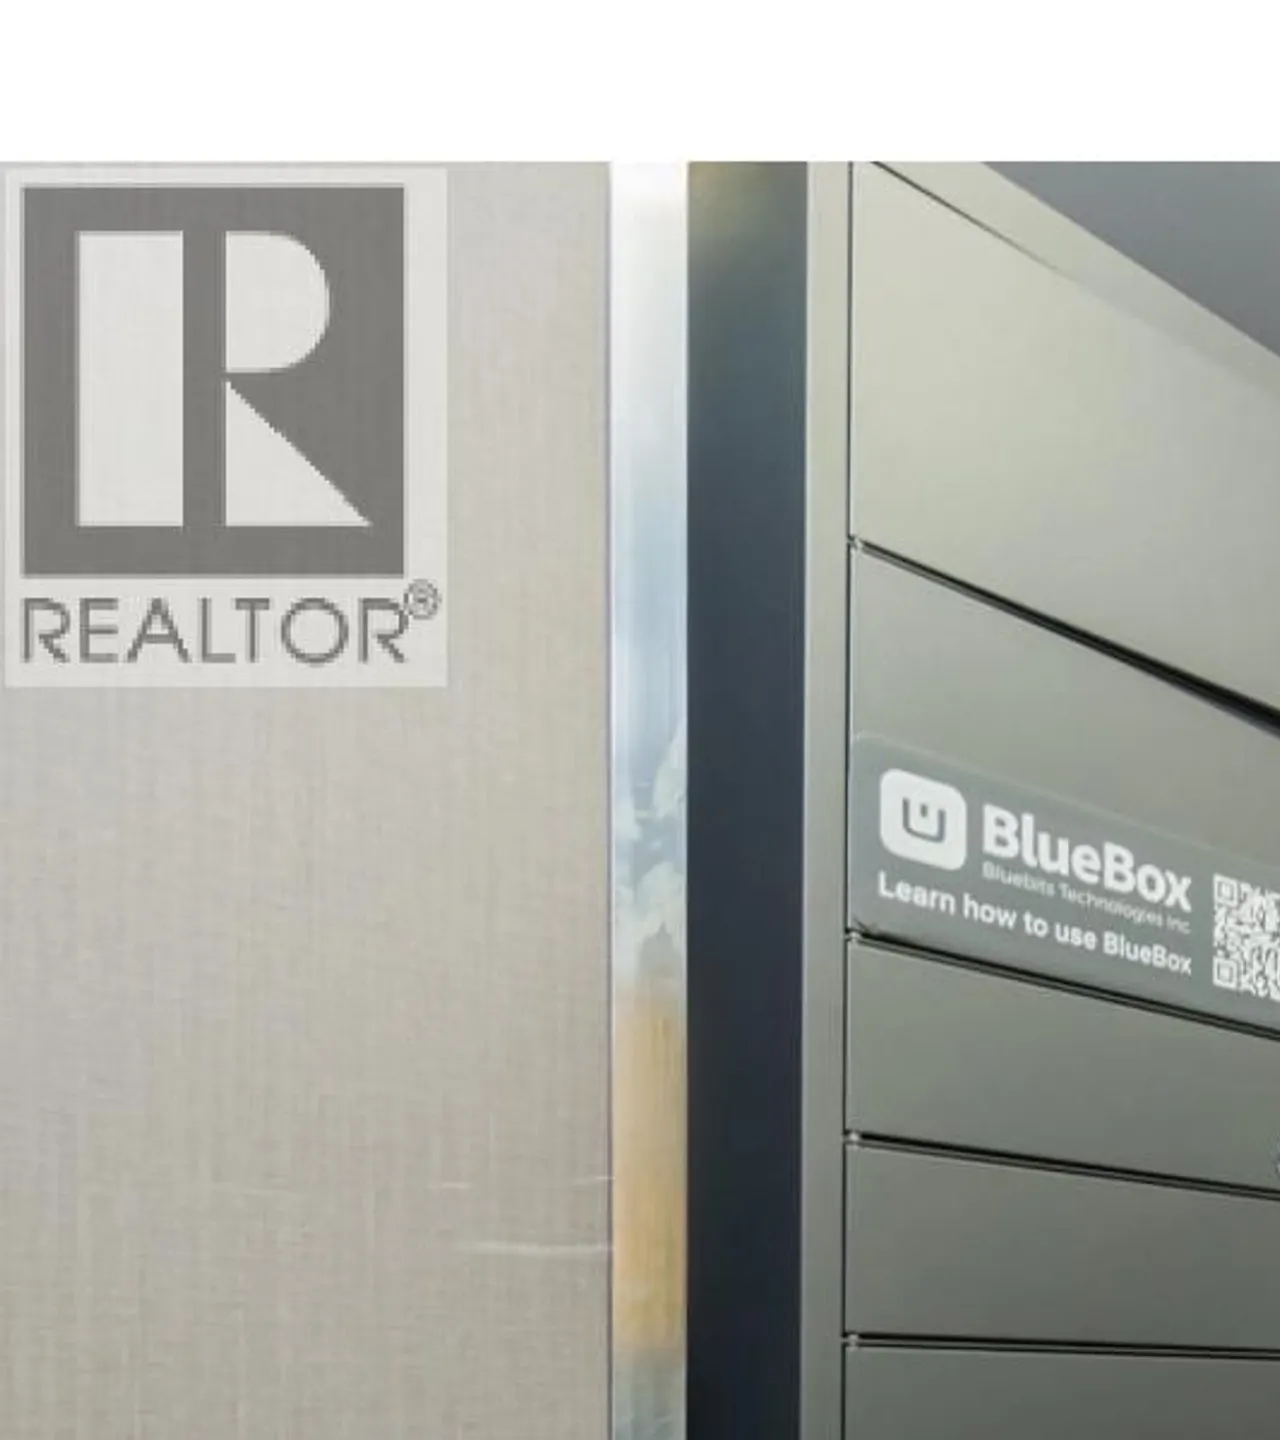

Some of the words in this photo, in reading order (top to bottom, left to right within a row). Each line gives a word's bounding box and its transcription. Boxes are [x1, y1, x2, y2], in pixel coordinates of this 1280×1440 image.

[982, 861, 1055, 898] Bluebits
[1060, 883, 1164, 928] Technologies
[983, 804, 1192, 912] BlueBox
[878, 871, 955, 916] Learn
[963, 893, 1018, 929] how
[1023, 911, 1048, 937] to
[1055, 925, 1098, 950] use
[1103, 931, 1193, 976] BlueBox
